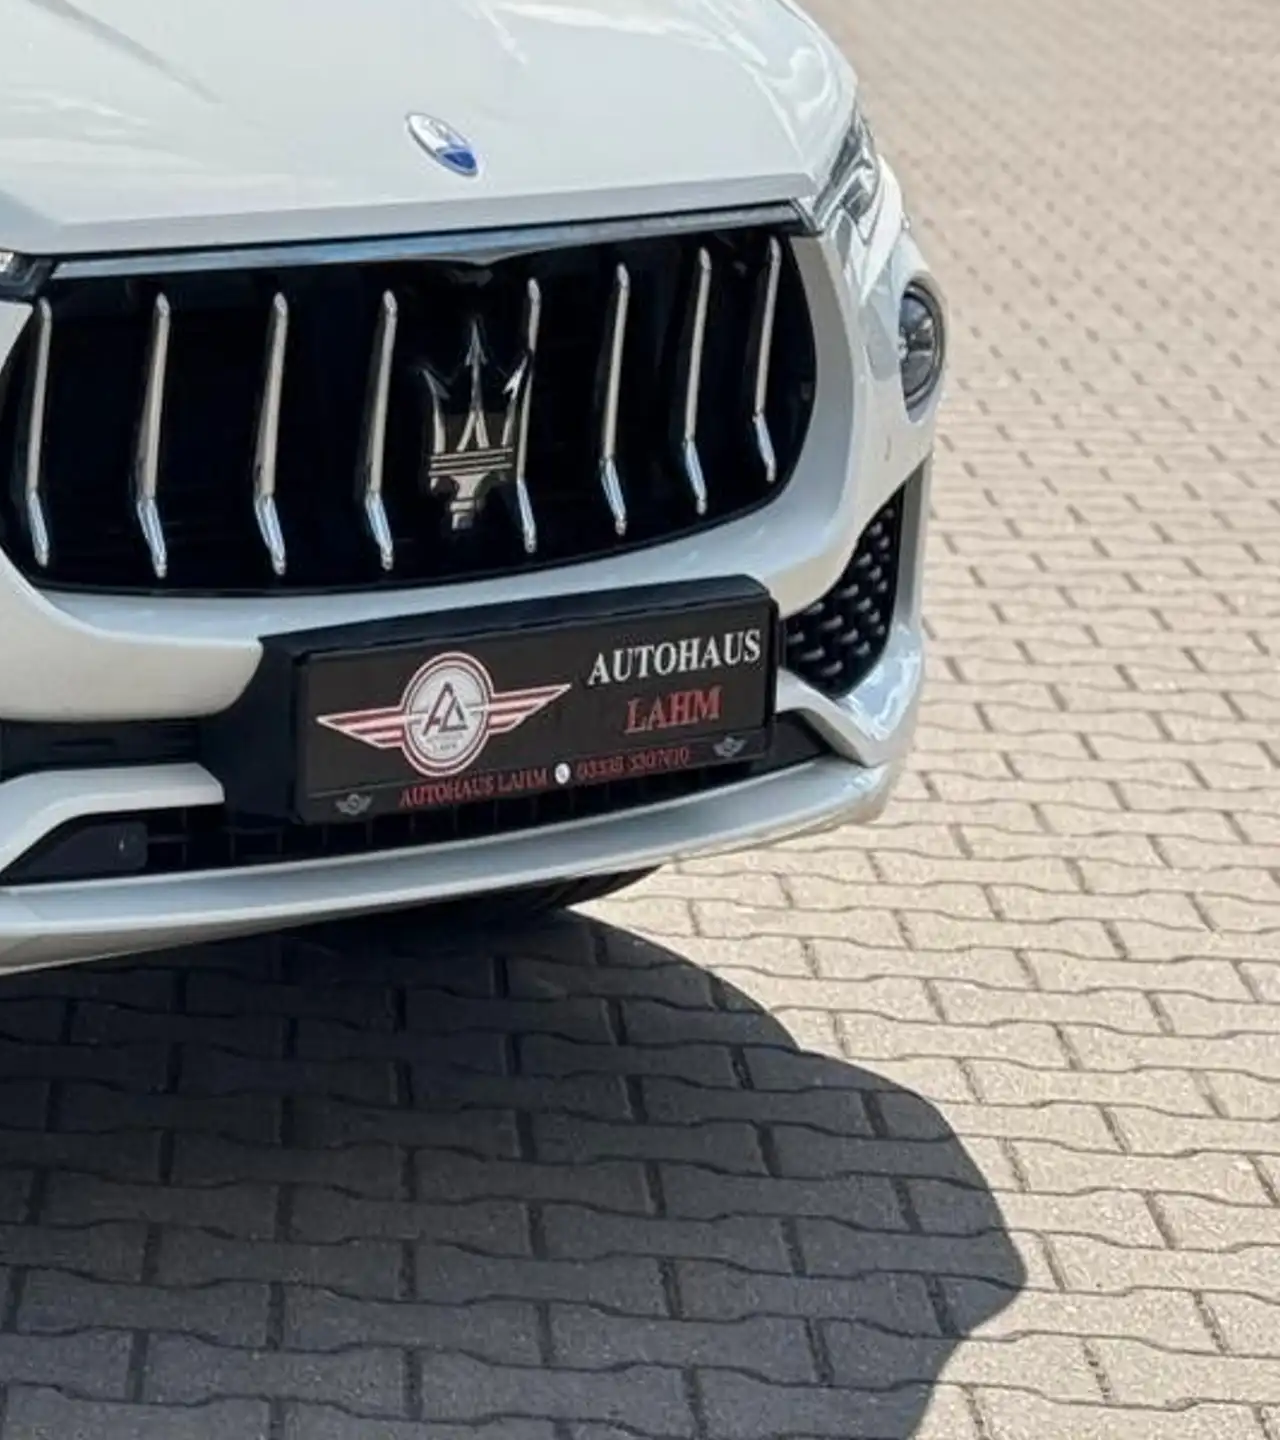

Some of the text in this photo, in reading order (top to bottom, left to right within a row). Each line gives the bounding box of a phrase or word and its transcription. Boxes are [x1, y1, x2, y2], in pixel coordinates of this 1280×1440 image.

[587, 628, 761, 686] AUTOHAUS
[624, 685, 723, 735] LAHM
[399, 775, 494, 808] AUTOHAUS
